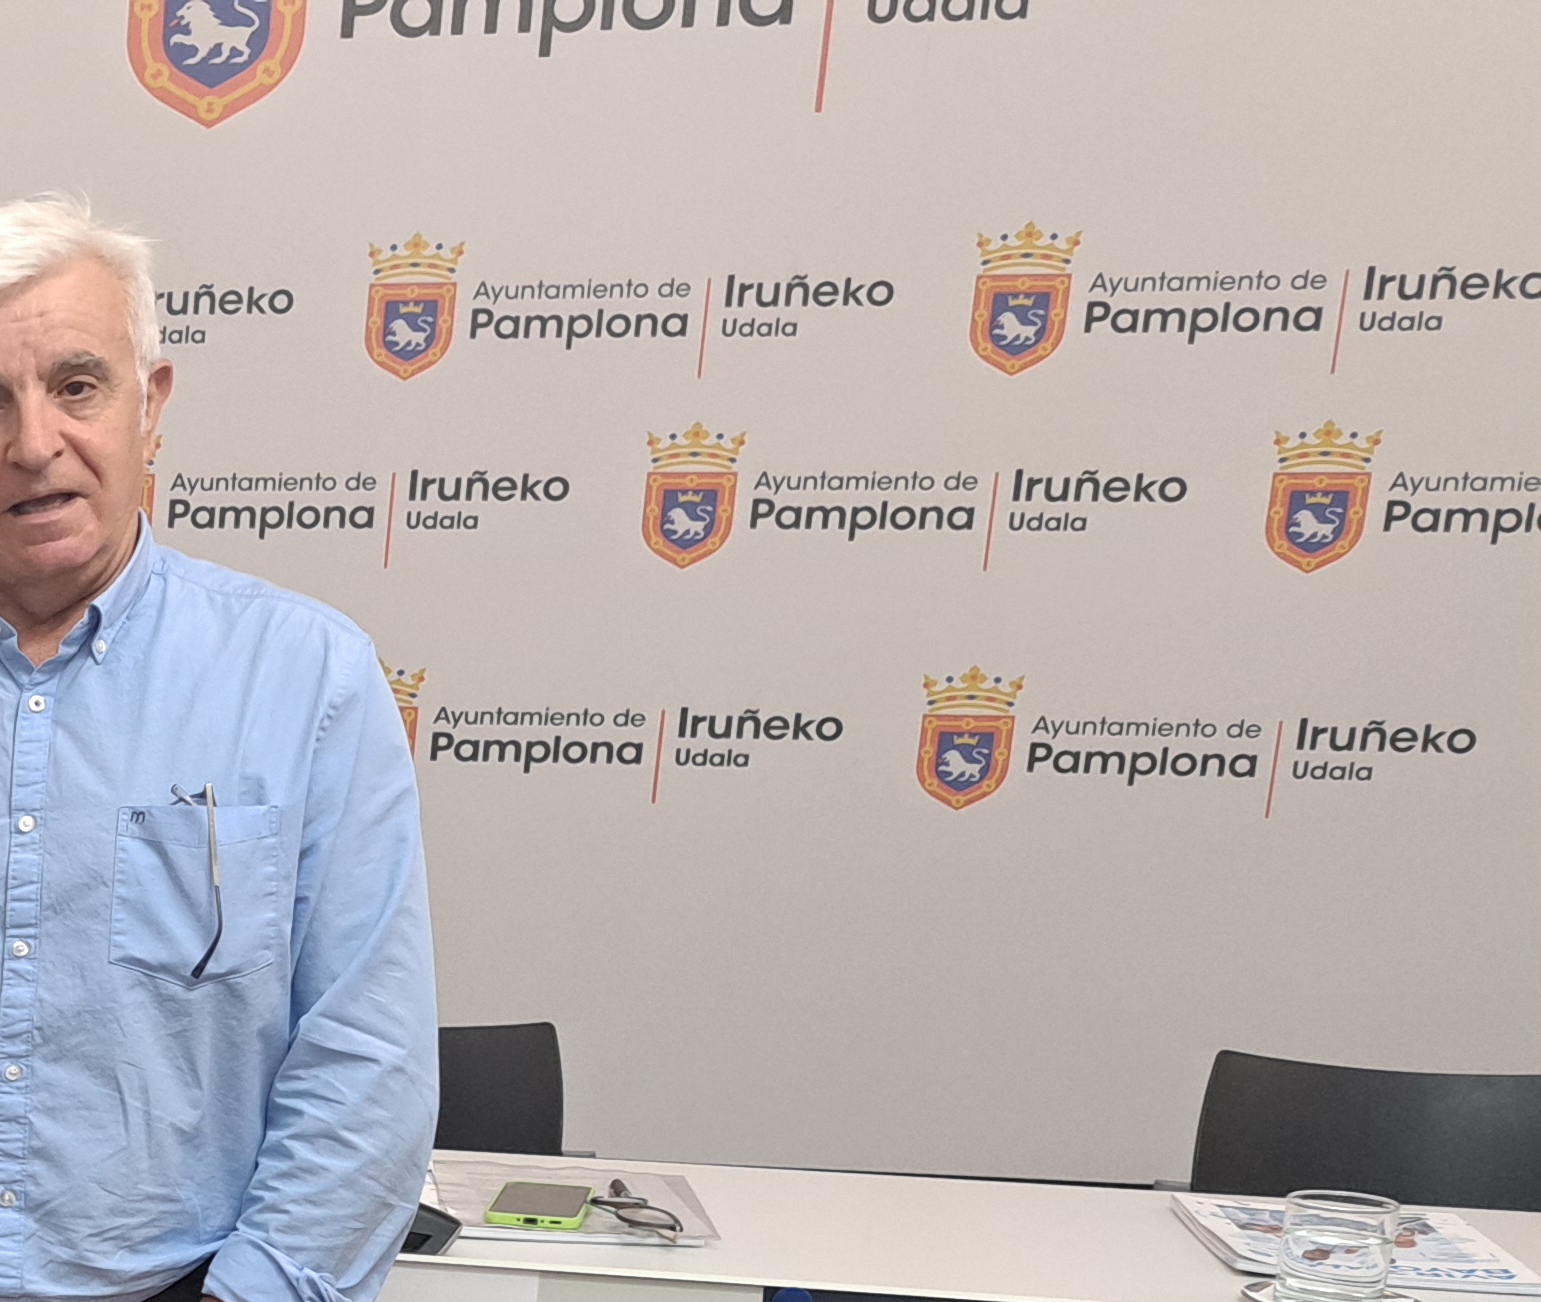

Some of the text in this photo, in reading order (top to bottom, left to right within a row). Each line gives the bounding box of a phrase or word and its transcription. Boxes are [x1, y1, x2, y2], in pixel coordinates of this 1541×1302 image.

[473, 278, 691, 304] Ayuntamiento de
[725, 274, 894, 307] Iruñeko
[1089, 270, 1327, 297] Ayuntamiento de
[155, 284, 293, 316] ruñeko
[160, 325, 205, 344] dala
[470, 308, 688, 350] Pamplona
[722, 318, 797, 337] Udala
[1084, 301, 1323, 344] Pamplona
[1360, 311, 1442, 331] Udala
[170, 472, 376, 495] Ayuntamiento de
[409, 469, 569, 501] Iruñeko
[754, 471, 978, 495] Ayuntamiento de
[1012, 469, 1187, 502] Iruñeko
[1389, 472, 1541, 496] Ayuntamie
[168, 499, 374, 540] Pamplona
[407, 511, 478, 529] Udala
[750, 498, 975, 541] Pamplona
[1009, 512, 1087, 531] Udala
[1383, 500, 1541, 545] Pampl
[433, 707, 646, 729] Ayuntamiento de
[678, 707, 843, 741] Iruñeko
[1031, 716, 1261, 739] Ayuntamiento de
[1296, 718, 1476, 754] Iruñeko
[430, 732, 643, 774] Pamplona
[675, 748, 749, 767] Udala
[1027, 742, 1257, 786] Pamplona
[1293, 761, 1373, 781] Udala
